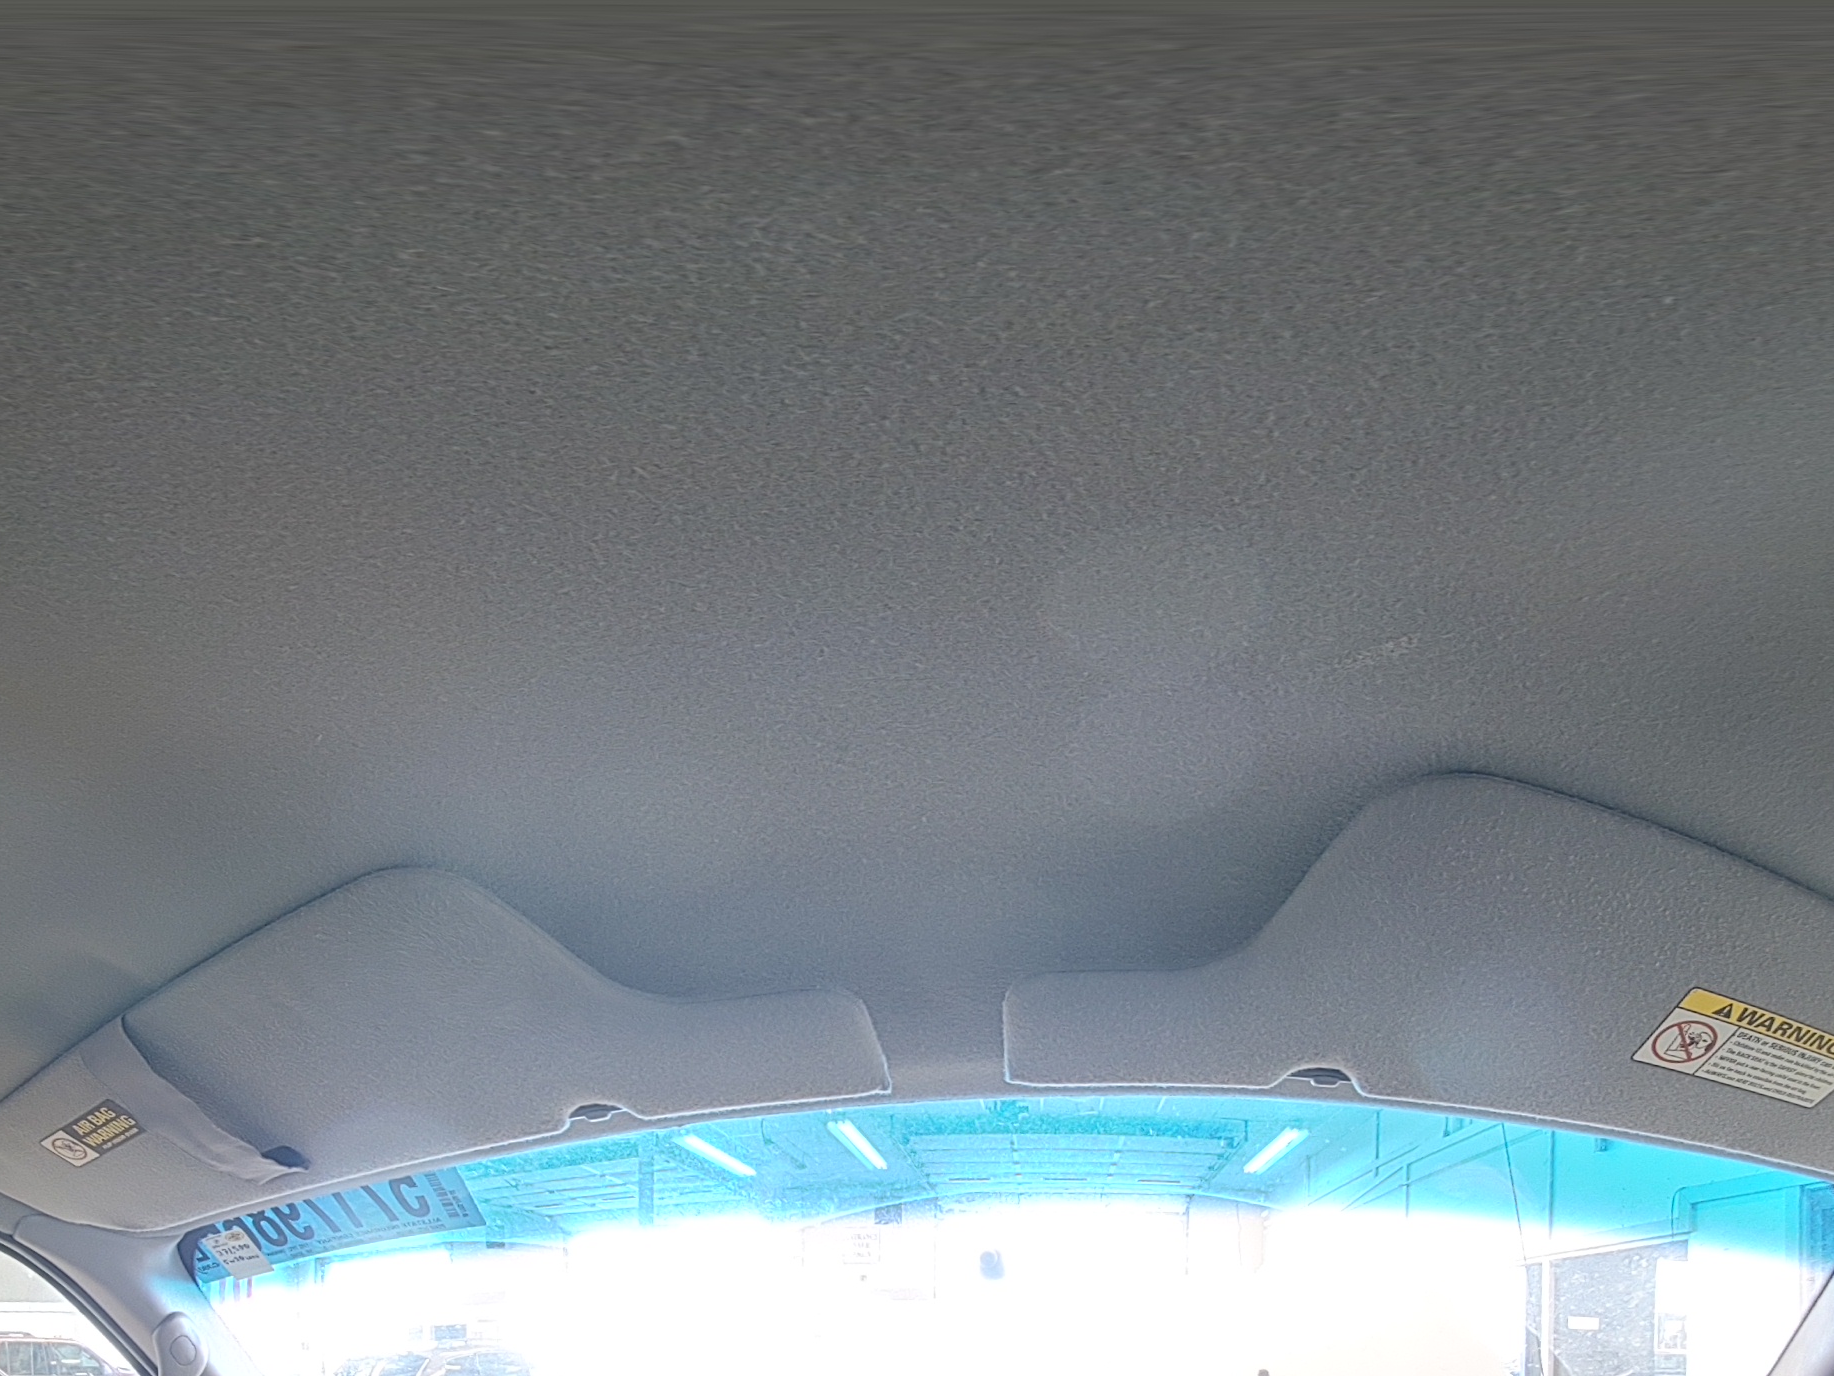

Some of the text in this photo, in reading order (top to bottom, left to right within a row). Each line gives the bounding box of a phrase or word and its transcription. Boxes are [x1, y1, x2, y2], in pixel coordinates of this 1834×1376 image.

[1736, 1031, 1762, 1043] DEATH
[1768, 1042, 1798, 1055] SERIOUS
[1797, 1052, 1822, 1063] INJURY
[72, 1107, 116, 1136] AIR BAG
[82, 1115, 136, 1147] WARNING
